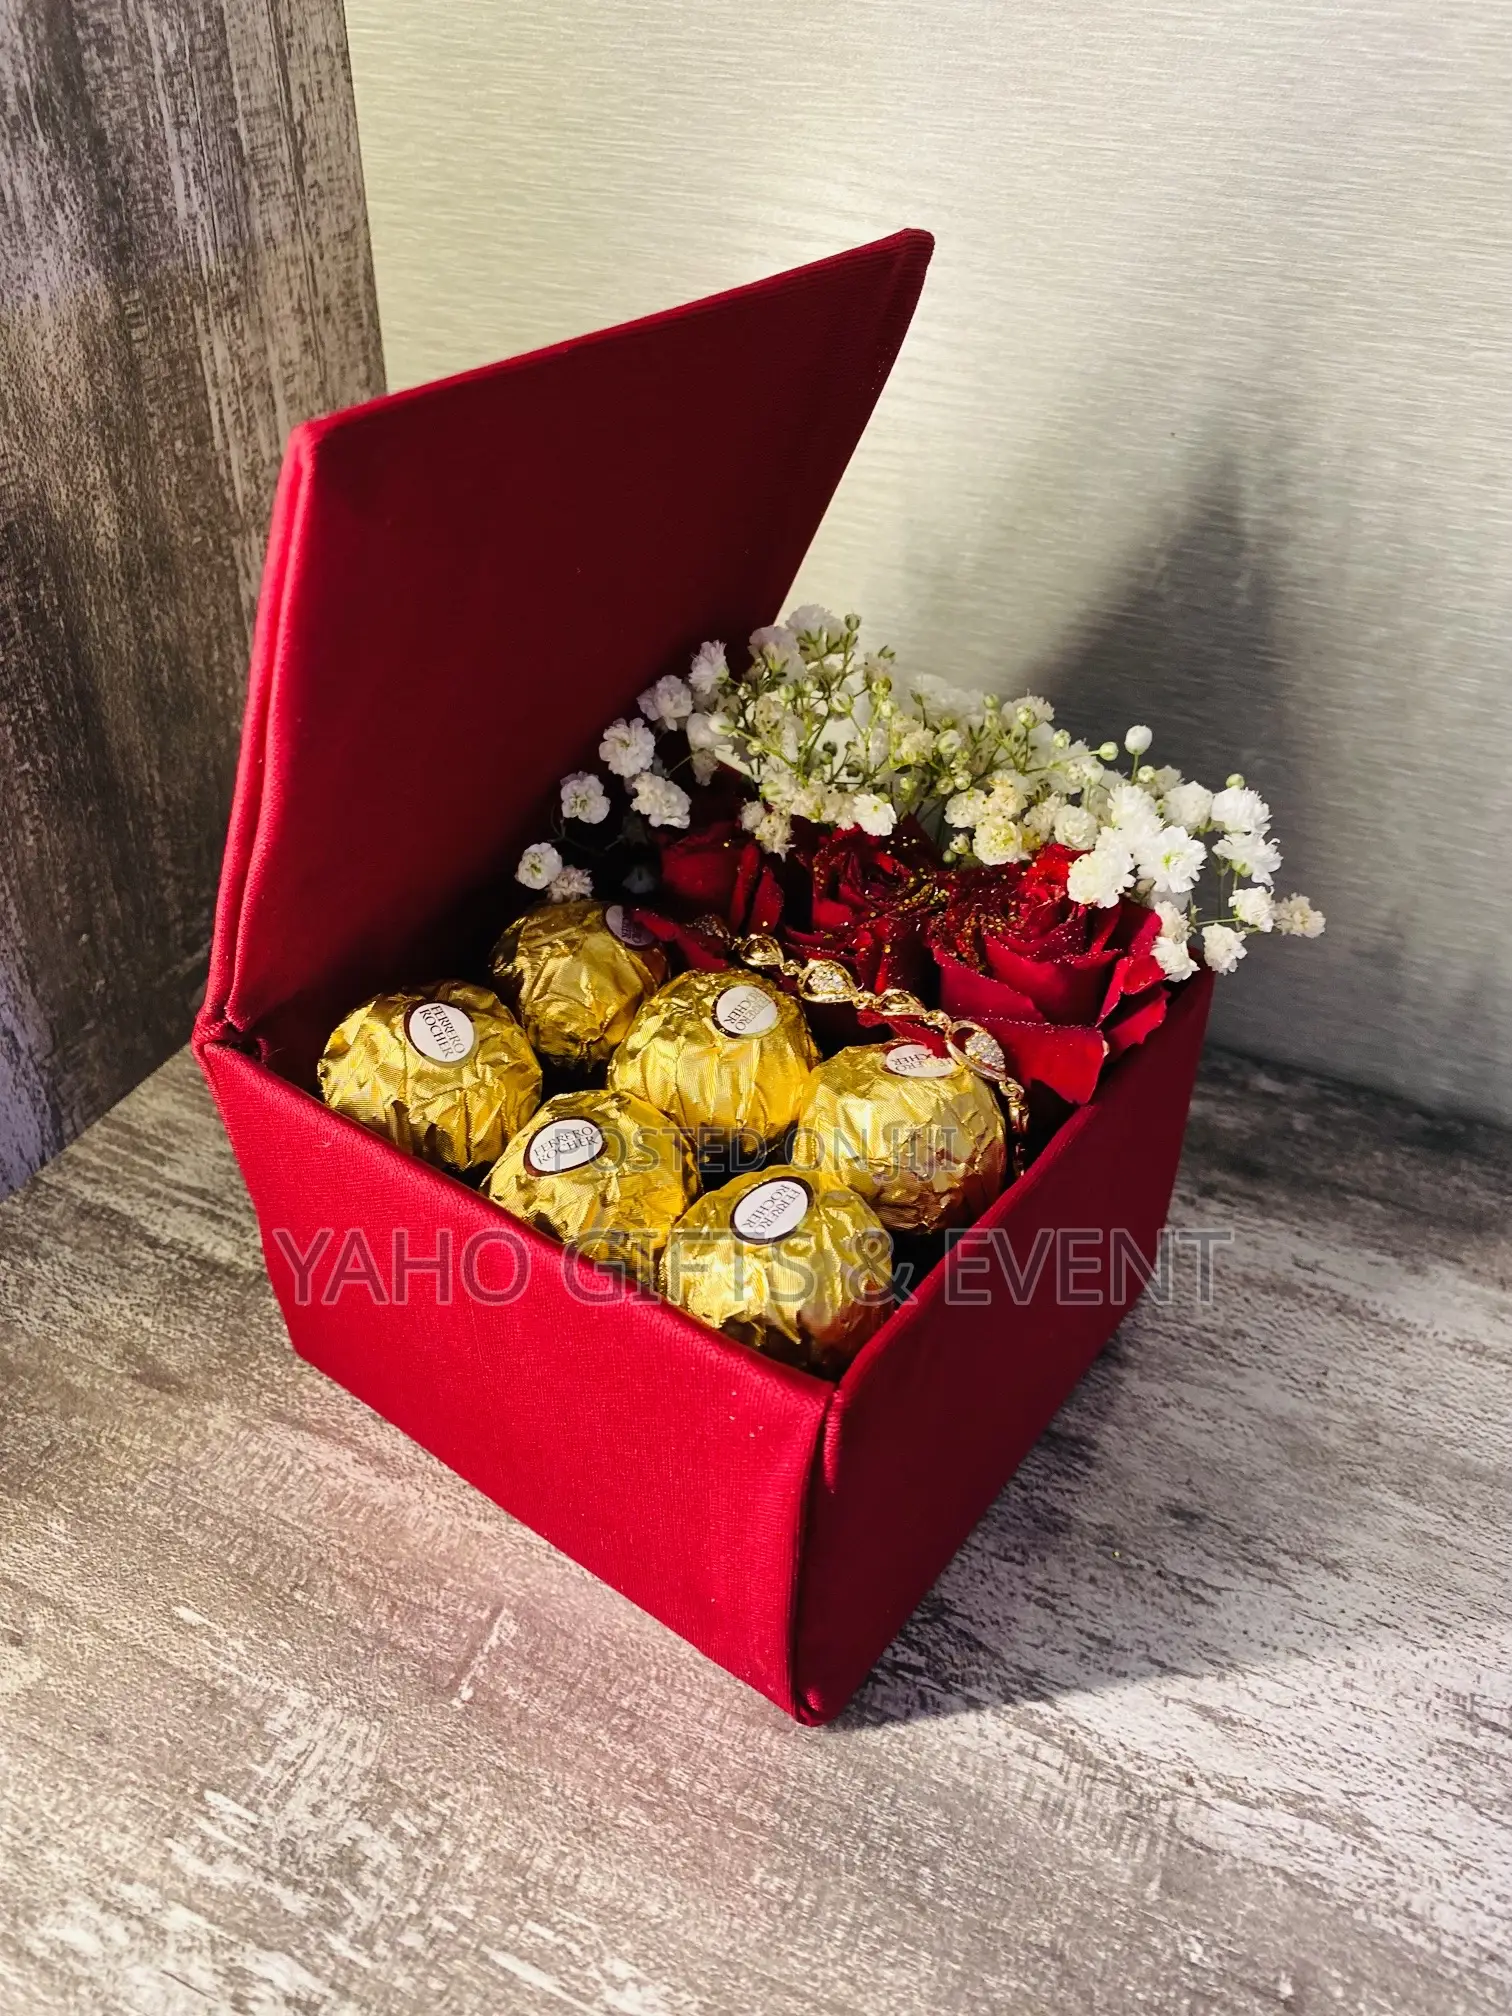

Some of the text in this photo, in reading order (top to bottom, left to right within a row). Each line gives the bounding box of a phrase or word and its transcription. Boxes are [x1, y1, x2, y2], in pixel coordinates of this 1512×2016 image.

[419, 1008, 454, 1058] ROCHER
[430, 1005, 465, 1054] FERRERO
[533, 1126, 594, 1157] FERRERO
[537, 1136, 599, 1165] ROCHER
[741, 1184, 790, 1228] ROCHER
[755, 1188, 801, 1235] FERRERO
